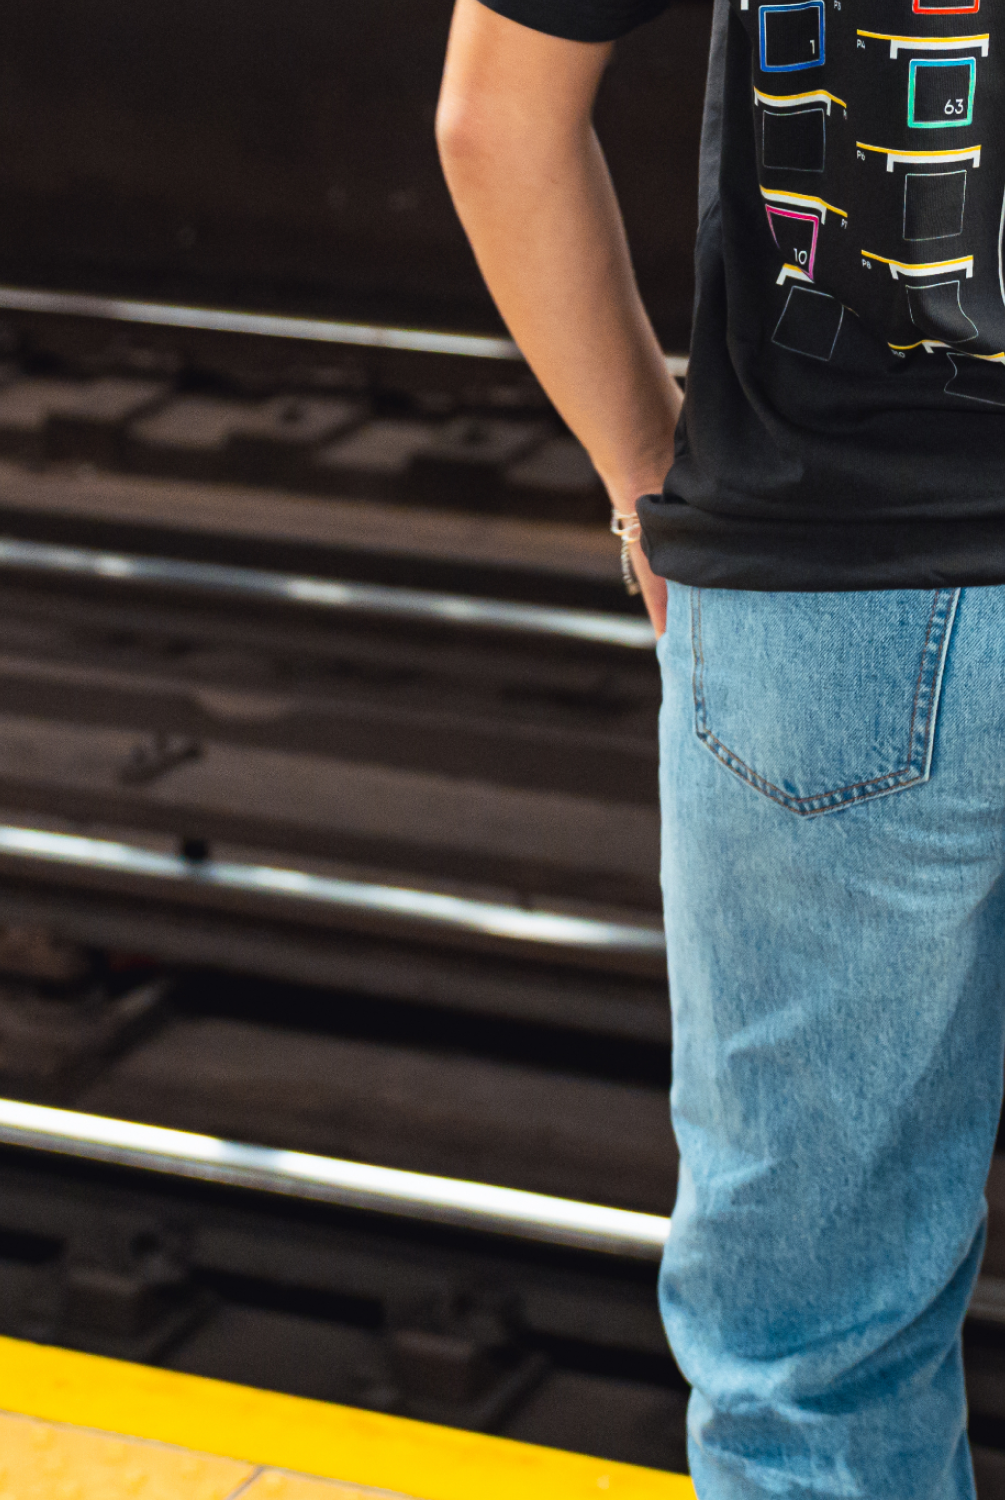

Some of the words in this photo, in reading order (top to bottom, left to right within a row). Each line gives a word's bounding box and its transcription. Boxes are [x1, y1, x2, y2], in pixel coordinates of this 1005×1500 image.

[808, 39, 816, 55] 1
[856, 39, 866, 50] P4
[943, 99, 964, 115] 63
[793, 248, 808, 265] 10
